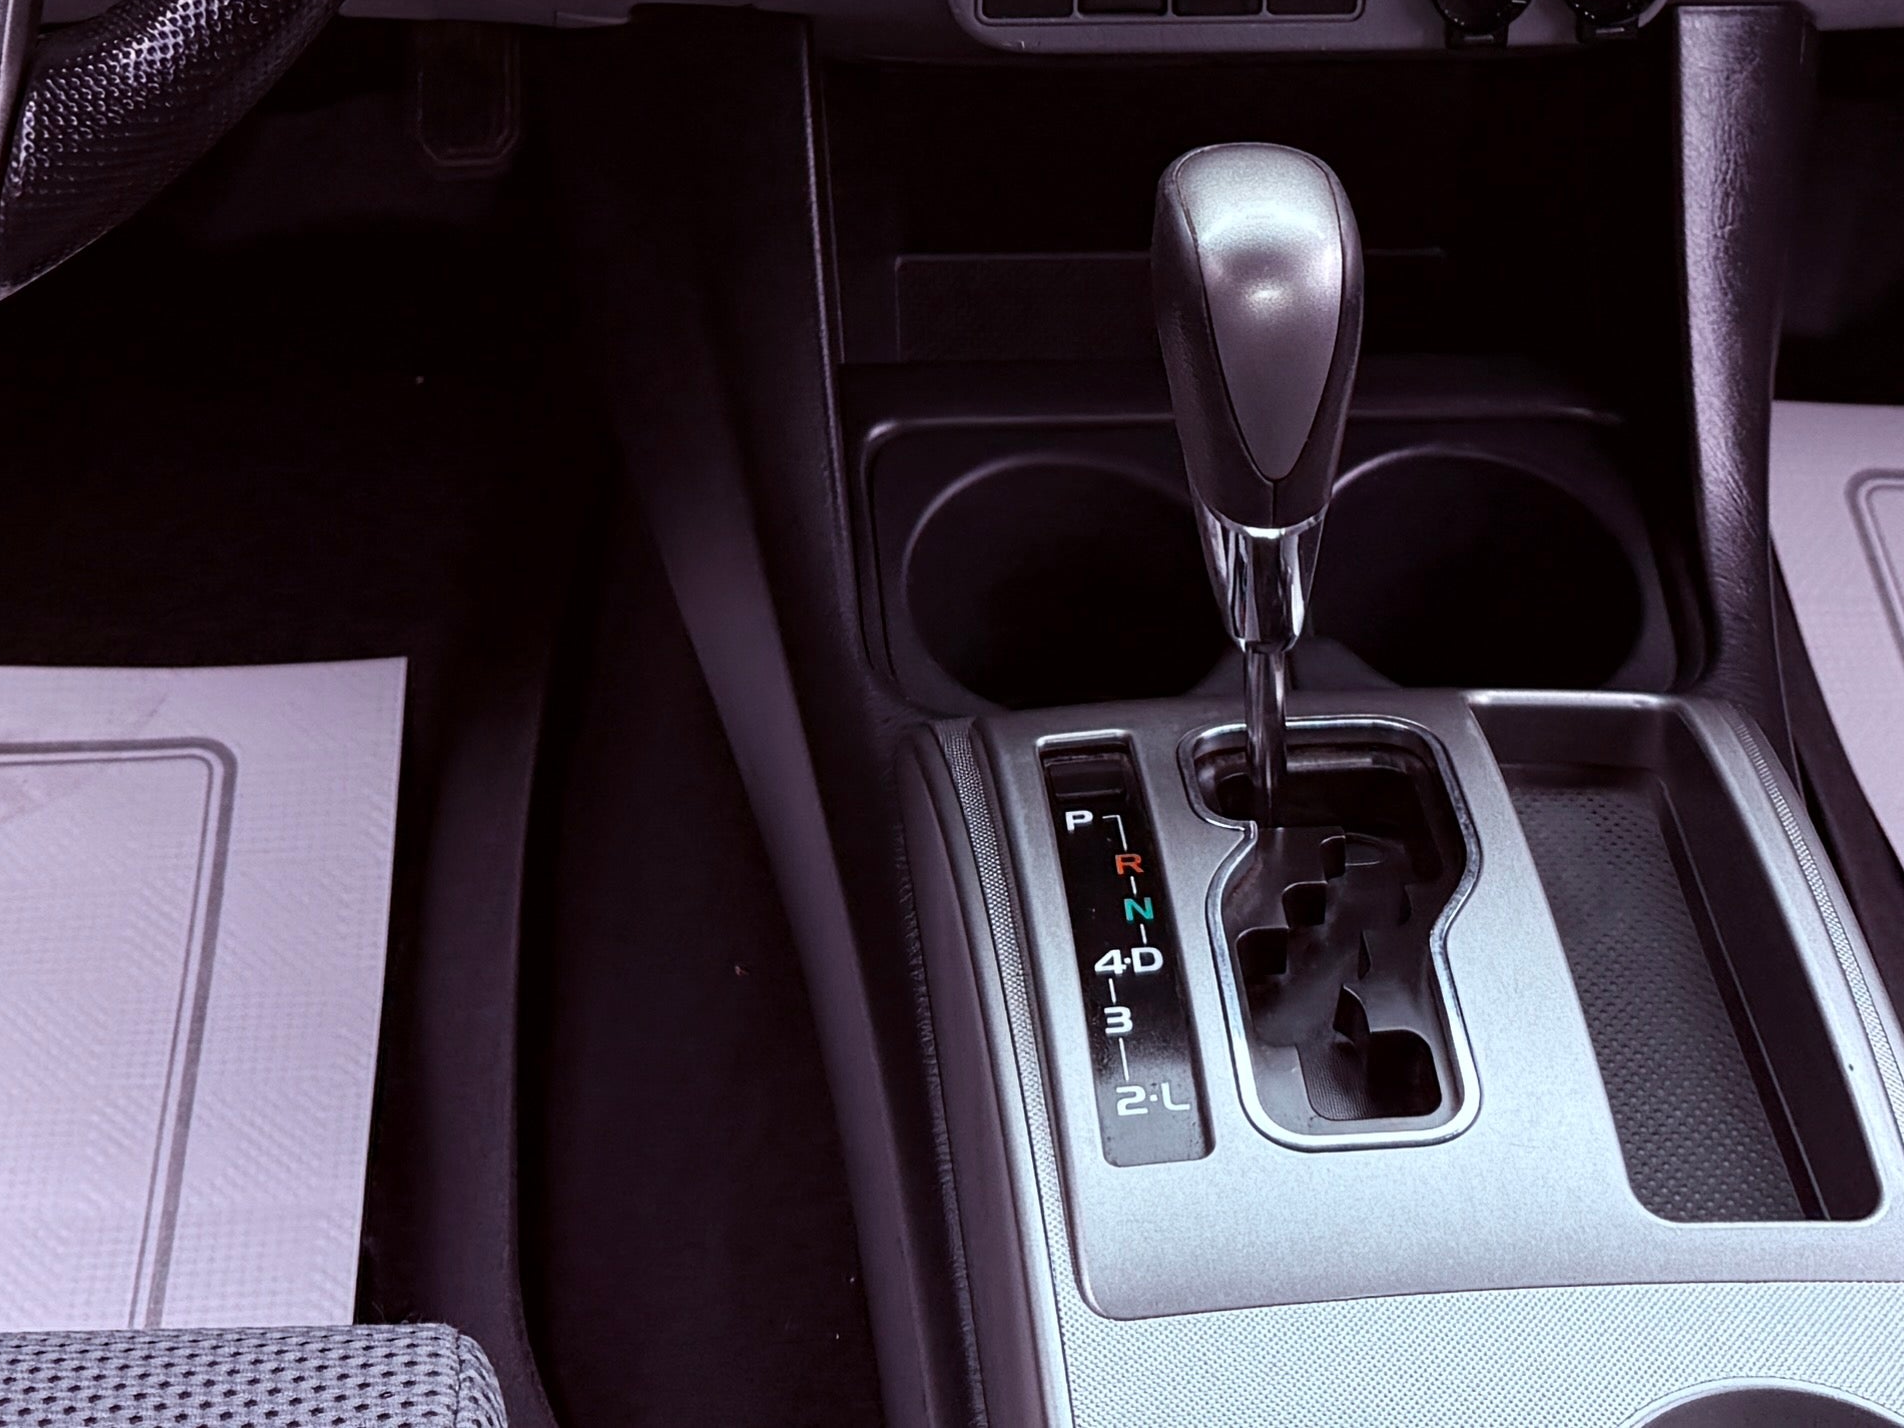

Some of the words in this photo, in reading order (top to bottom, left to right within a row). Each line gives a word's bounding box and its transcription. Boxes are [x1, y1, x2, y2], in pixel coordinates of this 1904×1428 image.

[1065, 811, 1094, 831] P
[1114, 853, 1144, 875] R
[1124, 897, 1154, 922] N
[1104, 1007, 1133, 1035] 3
